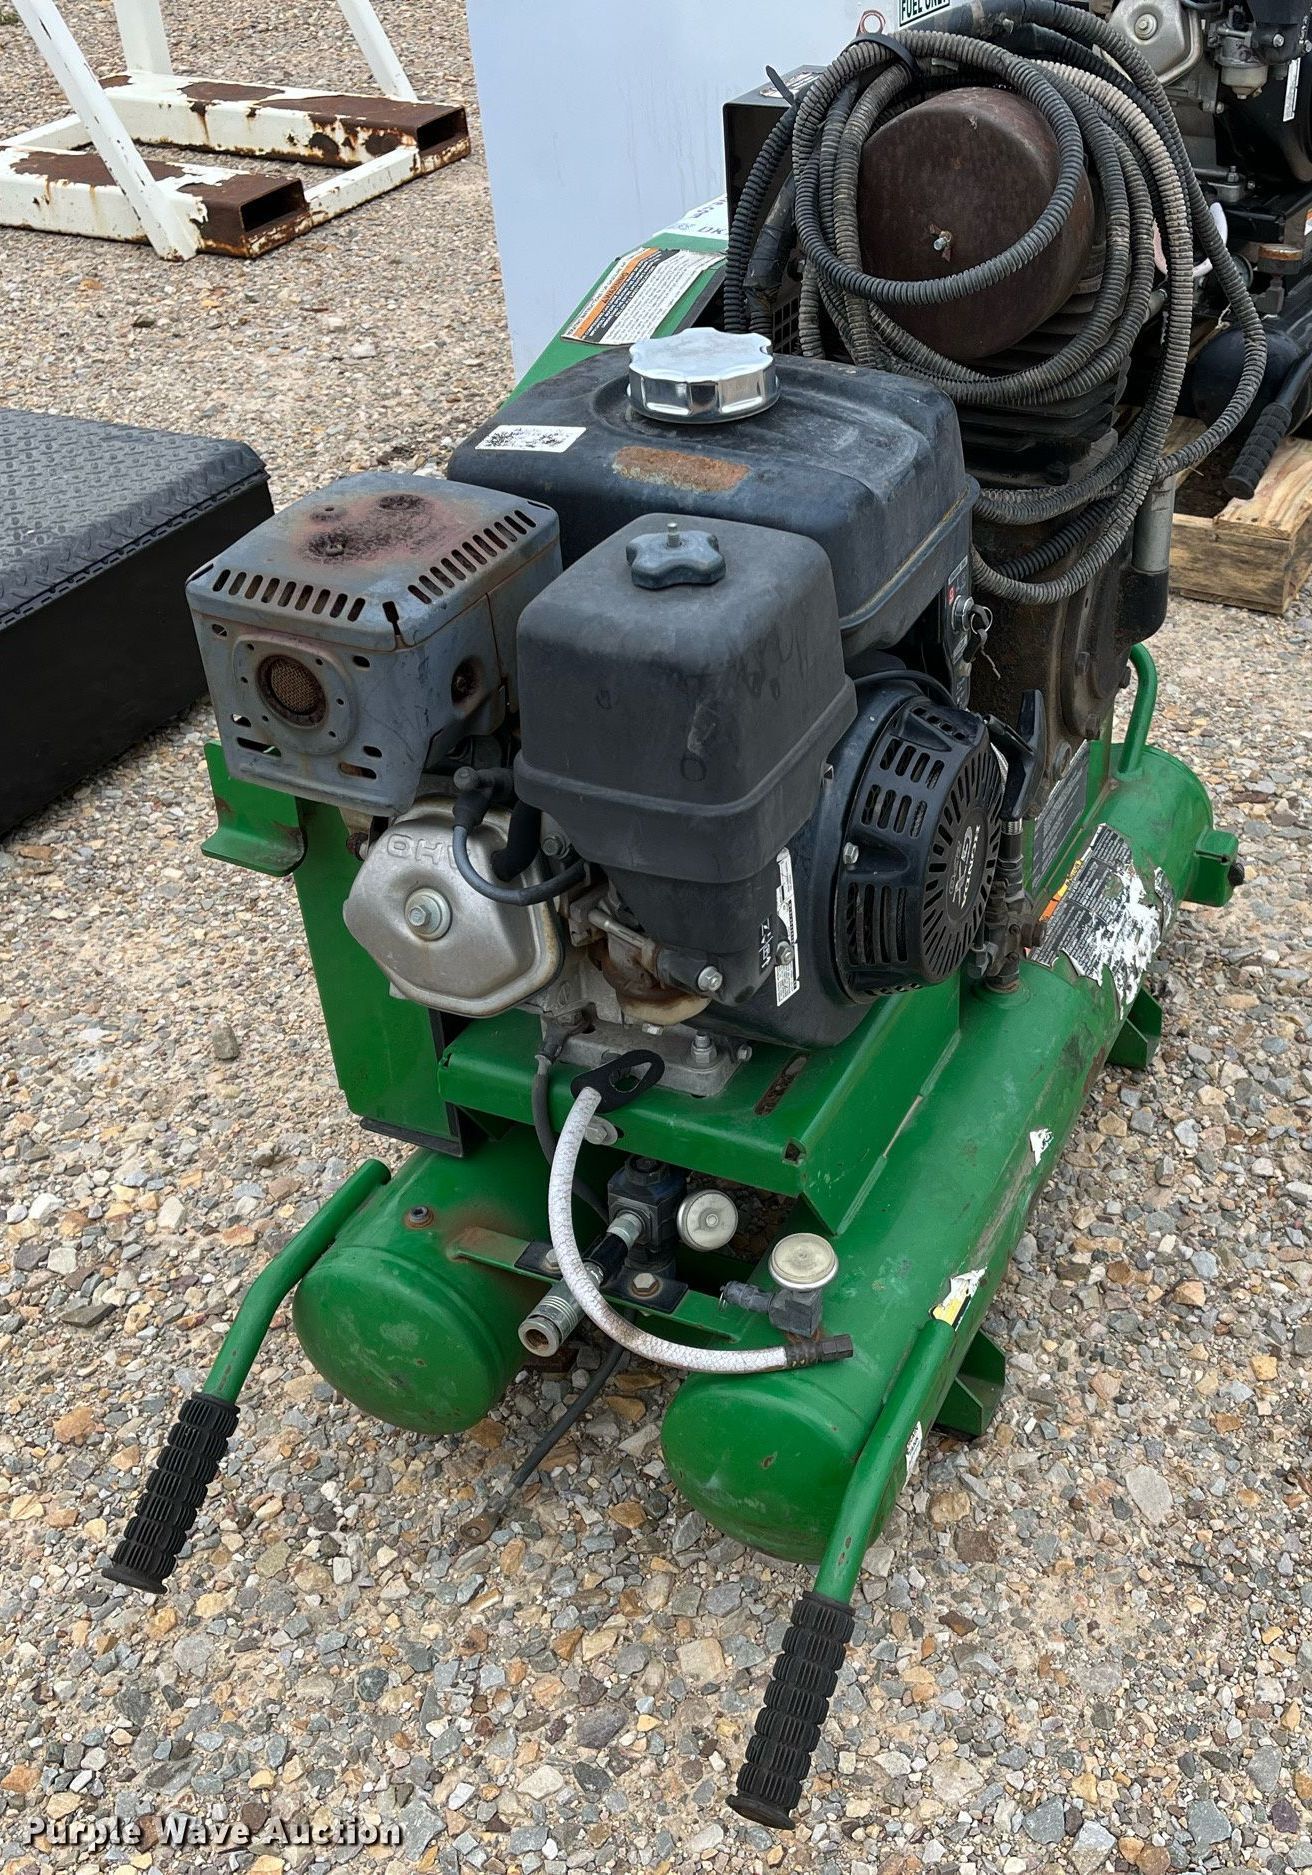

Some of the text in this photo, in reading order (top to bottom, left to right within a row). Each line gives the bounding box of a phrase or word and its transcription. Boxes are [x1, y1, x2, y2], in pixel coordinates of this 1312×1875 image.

[901, 0, 923, 21] FUEL
[387, 833, 470, 870] OH
[952, 825, 973, 907] GX
[960, 825, 981, 910] HONDA
